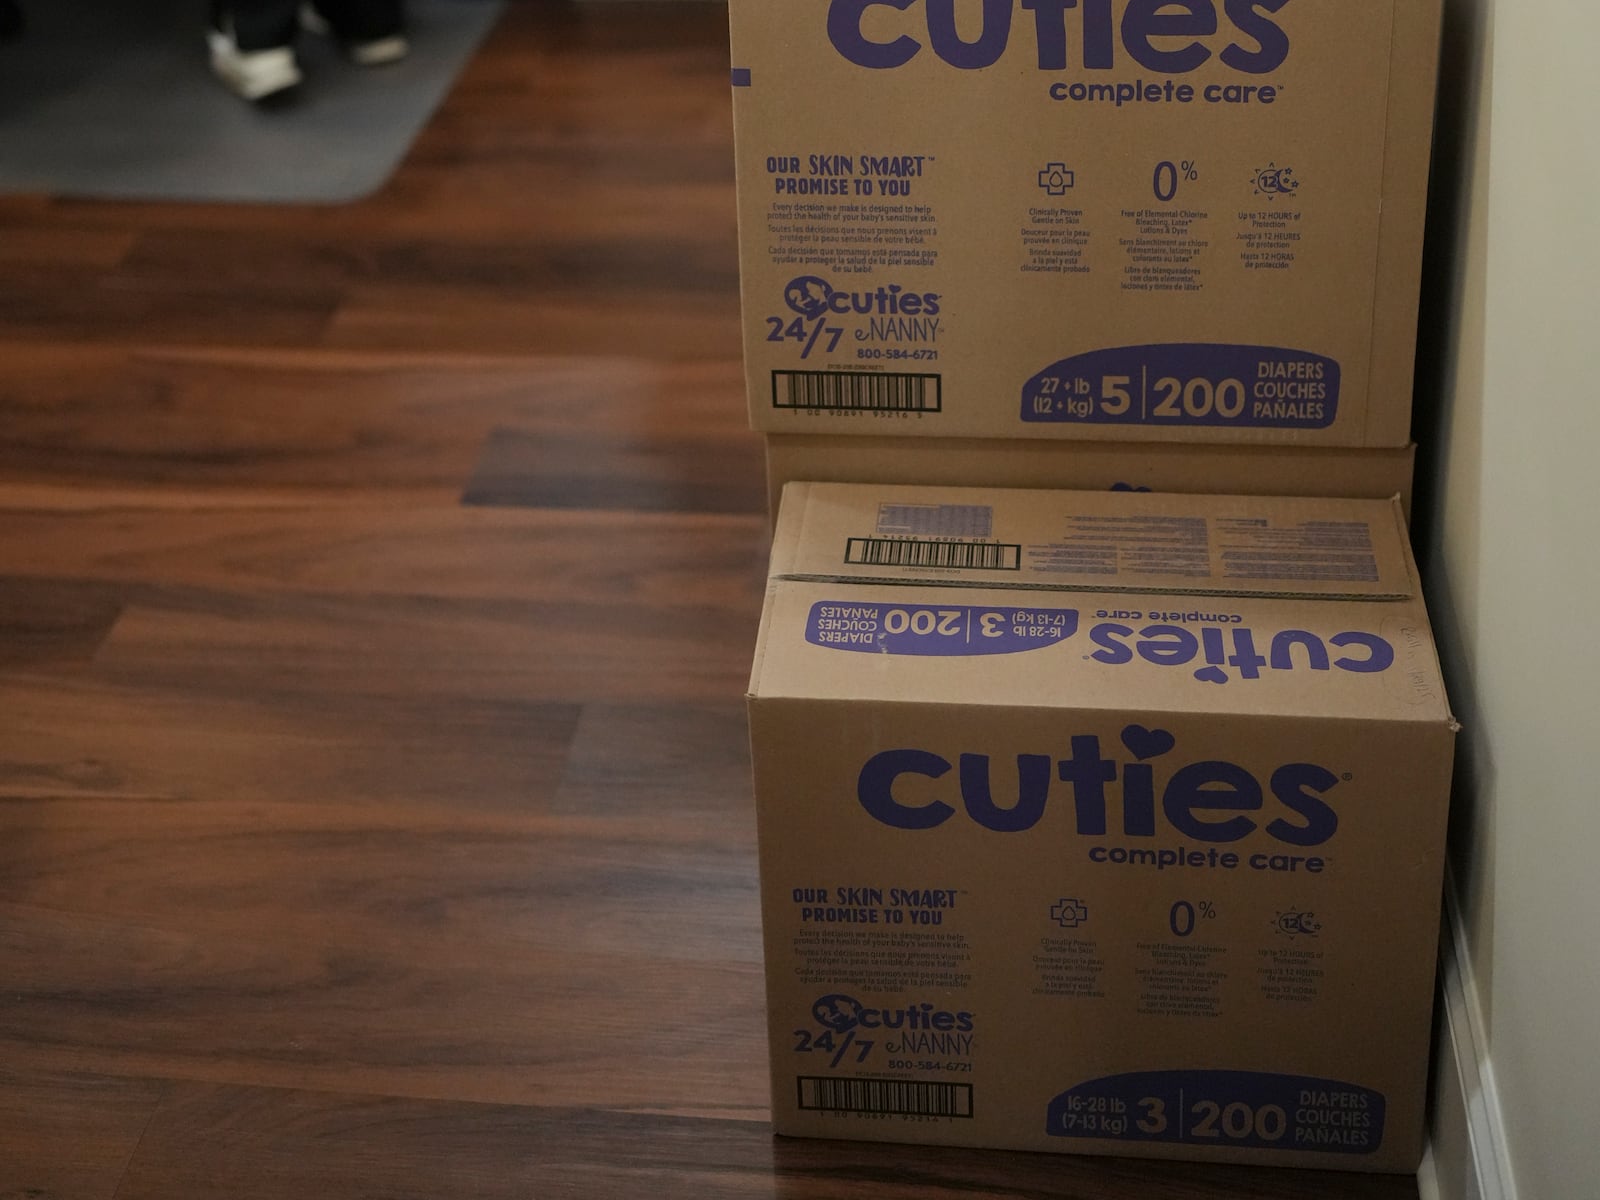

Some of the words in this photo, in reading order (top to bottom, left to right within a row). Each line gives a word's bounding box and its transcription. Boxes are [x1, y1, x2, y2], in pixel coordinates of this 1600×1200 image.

[1049, 79, 1195, 107] complete
[1203, 84, 1276, 104] care
[767, 156, 800, 173] OUR
[809, 155, 853, 176] SKIN
[860, 155, 925, 177] SMART
[775, 178, 848, 195] PROMISE
[854, 179, 872, 195] TO
[879, 179, 910, 196] YOU
[1261, 176, 1276, 187] 12
[794, 203, 824, 212] decision
[870, 204, 902, 214] designed
[914, 206, 931, 215] help
[808, 212, 831, 220] health
[842, 214, 859, 222] your
[886, 214, 919, 222] sensitive
[1274, 233, 1301, 241] HEURES
[828, 284, 940, 315] cuties
[766, 316, 844, 359] 24/7
[855, 317, 940, 342] eNANNY
[857, 349, 938, 360] 800-584-6721
[1257, 361, 1324, 380] DIAPERS
[1040, 377, 1059, 394] 27
[1075, 377, 1090, 394] lb
[1254, 380, 1326, 400] COUCHES
[1101, 375, 1131, 415] 5
[1153, 377, 1246, 418] 200
[1033, 397, 1052, 414] (12
[1067, 396, 1094, 418] kg)
[1253, 400, 1324, 420] PAÑALES
[820, 606, 878, 621] PAÑALES
[1012, 612, 1034, 626] kg)
[1036, 613, 1066, 626] (7-13
[1096, 609, 1143, 620] care
[1148, 610, 1243, 624] complete
[818, 618, 877, 632] COUCHES
[884, 609, 962, 636] 200
[979, 612, 1006, 638] 3
[1013, 626, 1026, 637] lb
[1029, 626, 1062, 638] 16-28
[819, 631, 873, 644] DIAPERS
[1089, 622, 1395, 684] cuties
[857, 724, 1339, 847] cuties
[1088, 846, 1240, 870] complete
[1248, 853, 1326, 874] care
[792, 888, 828, 903] OUR
[837, 888, 882, 906] SKIN
[890, 889, 957, 909] SMART
[802, 908, 878, 923] PROMISE
[884, 910, 903, 924] TO
[910, 910, 942, 925] YOU
[858, 1002, 974, 1032] cuties
[793, 1029, 875, 1068] 24/7
[886, 1031, 974, 1056] eNANNY
[888, 1059, 972, 1072] 800-584-6721
[1067, 1096, 1106, 1114] 16-28
[1110, 1098, 1127, 1114] lb
[1299, 1090, 1369, 1110] DIAPERS
[1062, 1114, 1097, 1130] (7-13
[1101, 1118, 1127, 1136] kg)
[1135, 1097, 1168, 1134] 3
[1190, 1100, 1287, 1141] 200
[1295, 1108, 1370, 1128] COUCHES
[1294, 1125, 1369, 1146] PAÑALES
